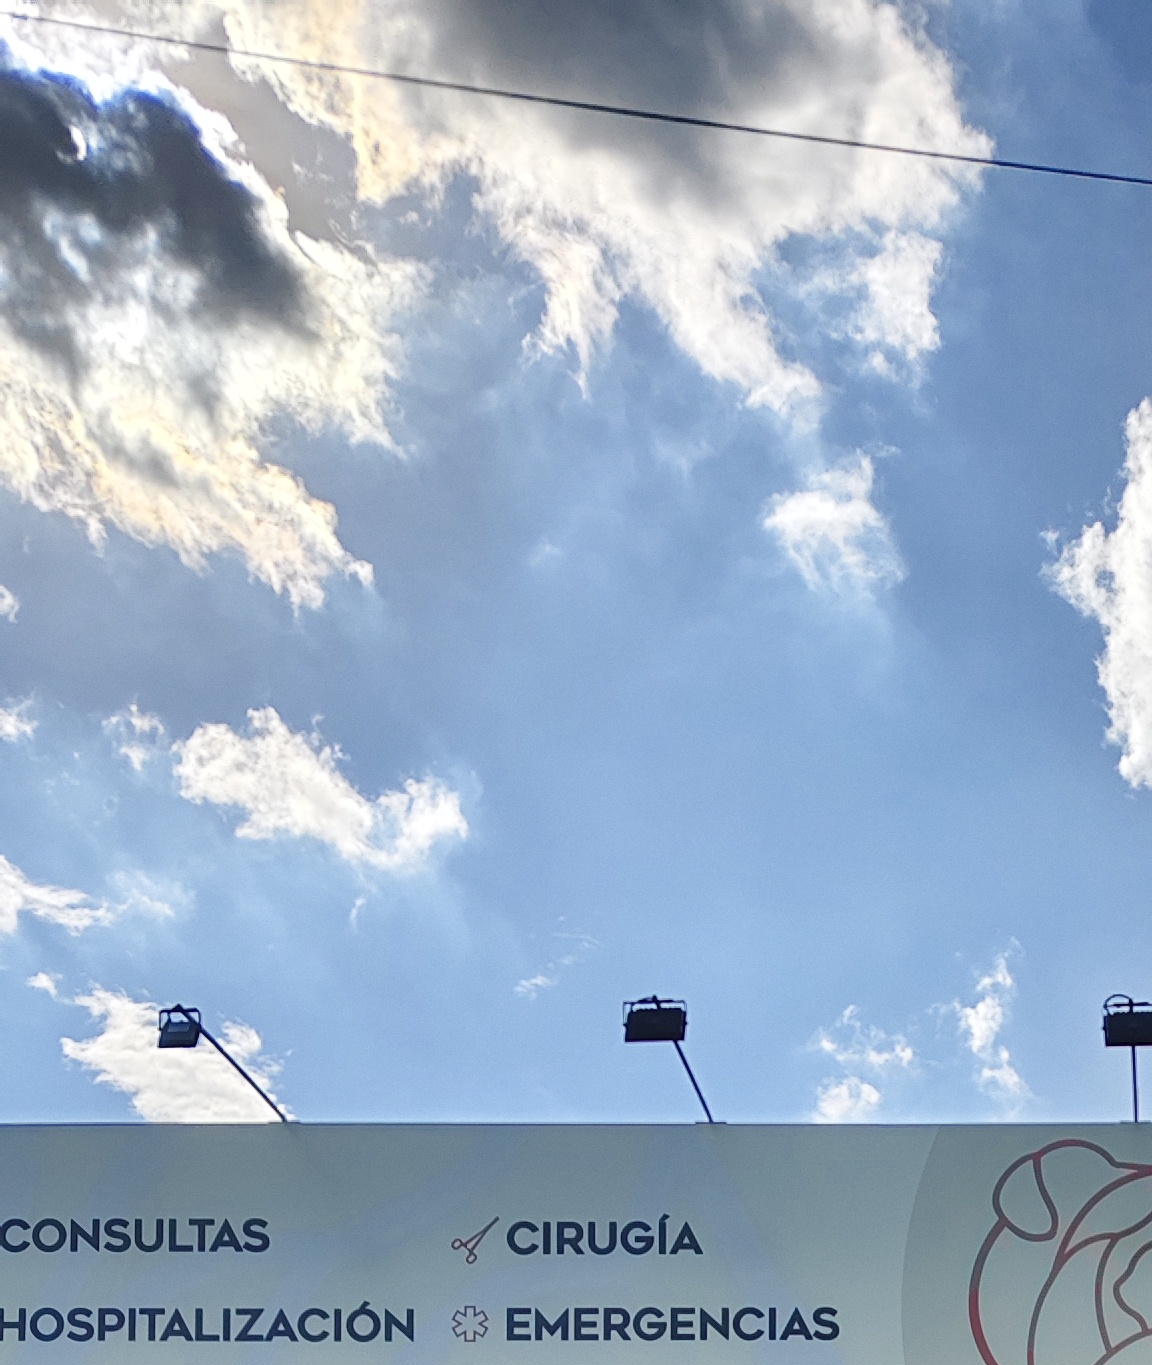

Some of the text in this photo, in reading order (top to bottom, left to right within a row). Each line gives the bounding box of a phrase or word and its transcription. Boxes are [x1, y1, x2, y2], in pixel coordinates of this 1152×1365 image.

[0, 1218, 271, 1253] CONSULTAS
[506, 1213, 704, 1256] CIRUGÍA
[0, 1301, 415, 1342] HOSPITALIZACIÓN
[506, 1306, 840, 1342] EMERGENCIAS
